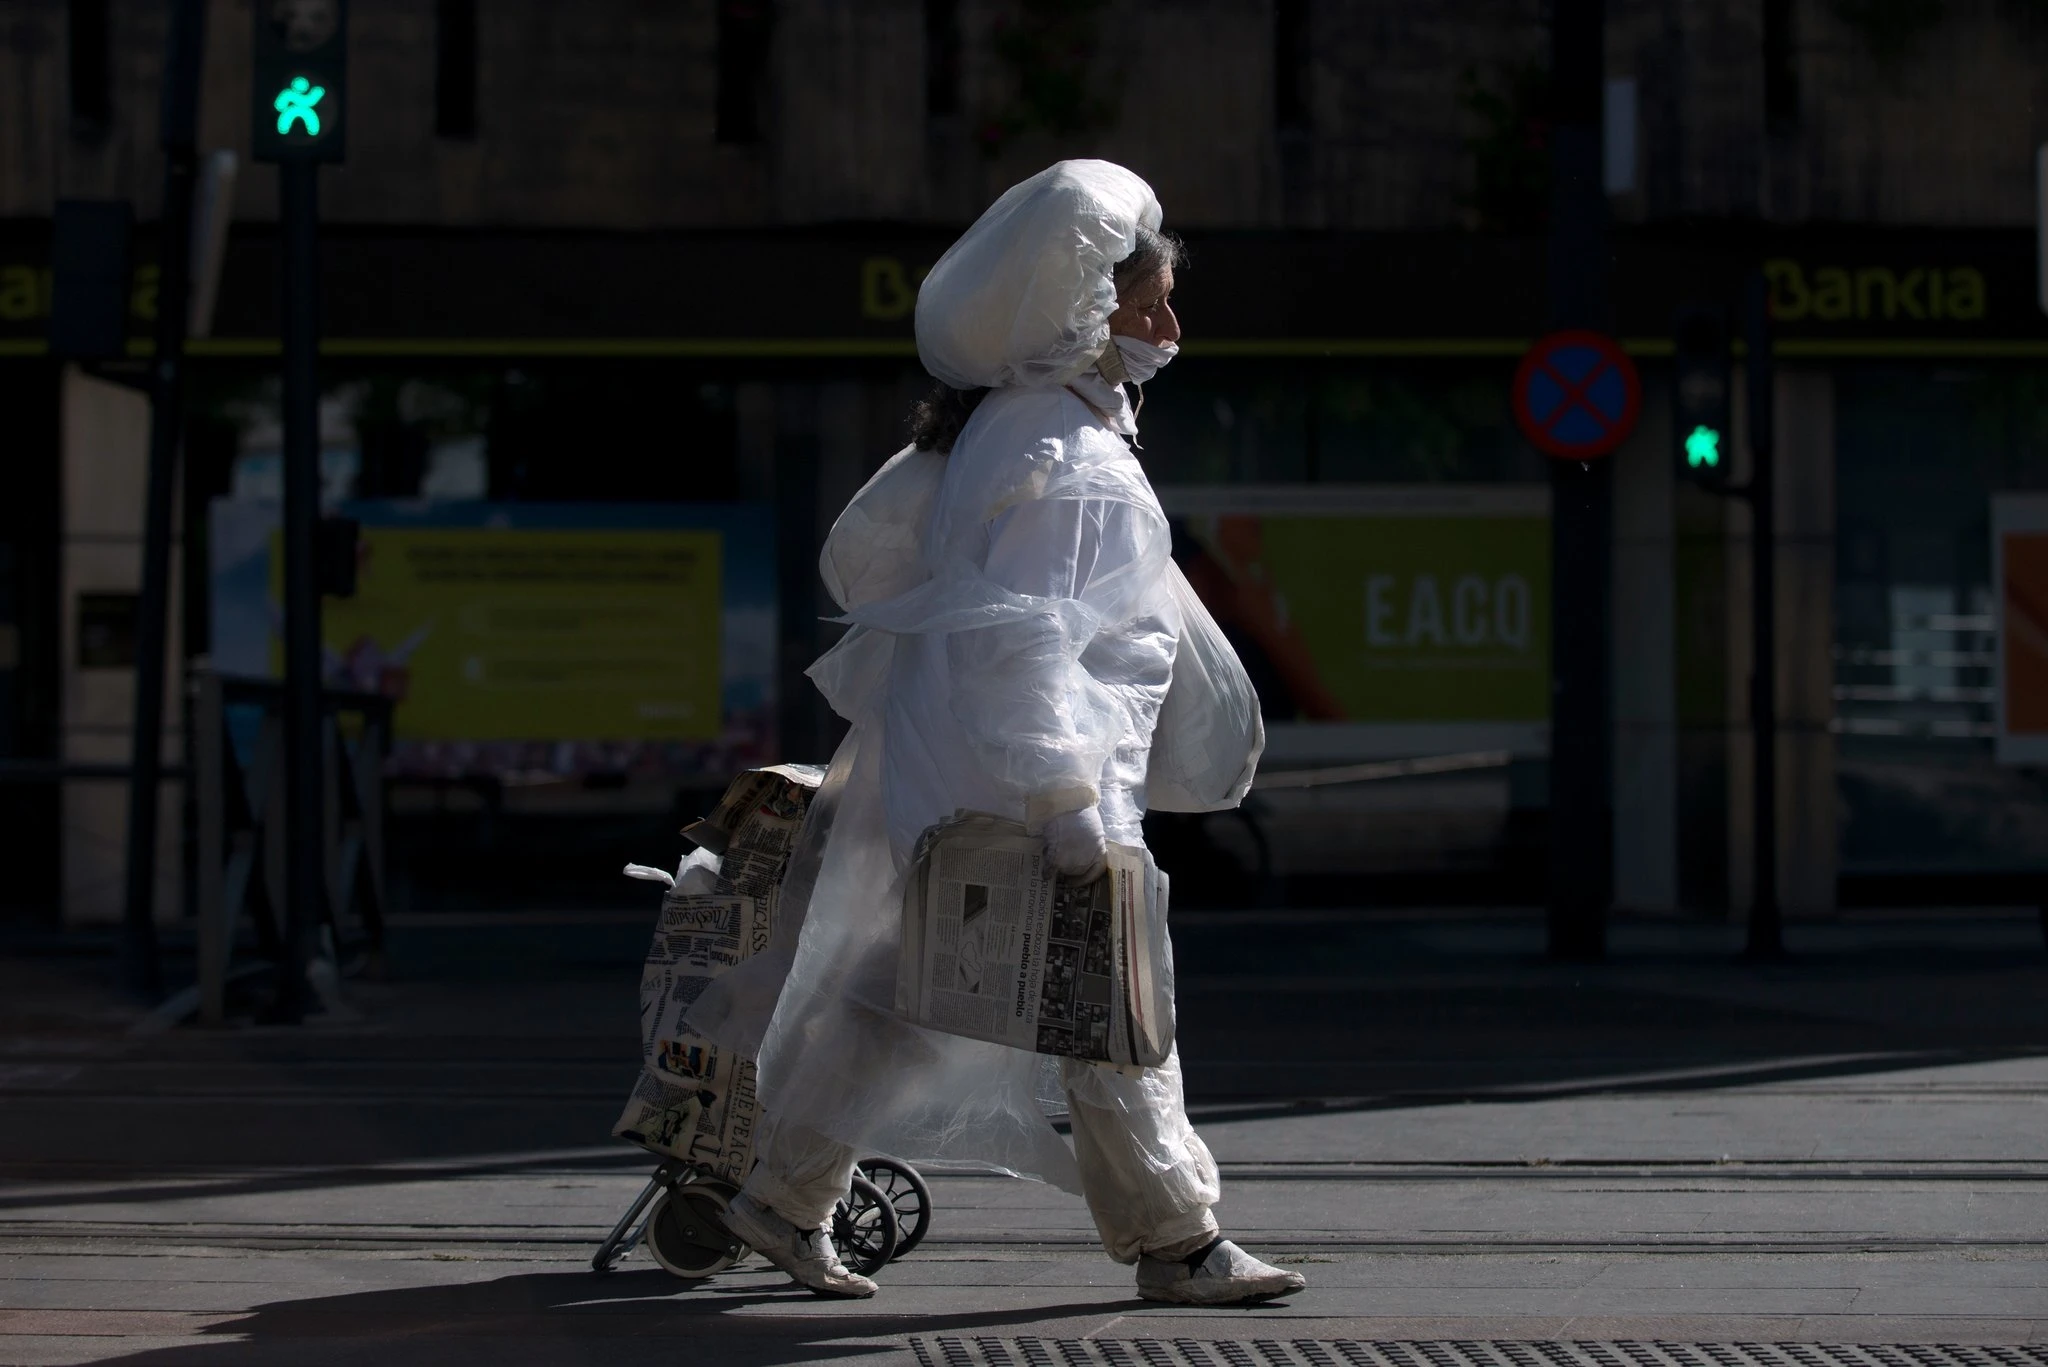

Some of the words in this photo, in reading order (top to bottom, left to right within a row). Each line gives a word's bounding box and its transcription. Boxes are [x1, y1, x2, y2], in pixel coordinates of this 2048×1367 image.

[1761, 256, 1990, 322] Bankia
[752, 897, 769, 956] PICASS
[1025, 889, 1038, 931] provincia
[1020, 933, 1031, 970] pueblo
[1015, 980, 1026, 1018] pueblo
